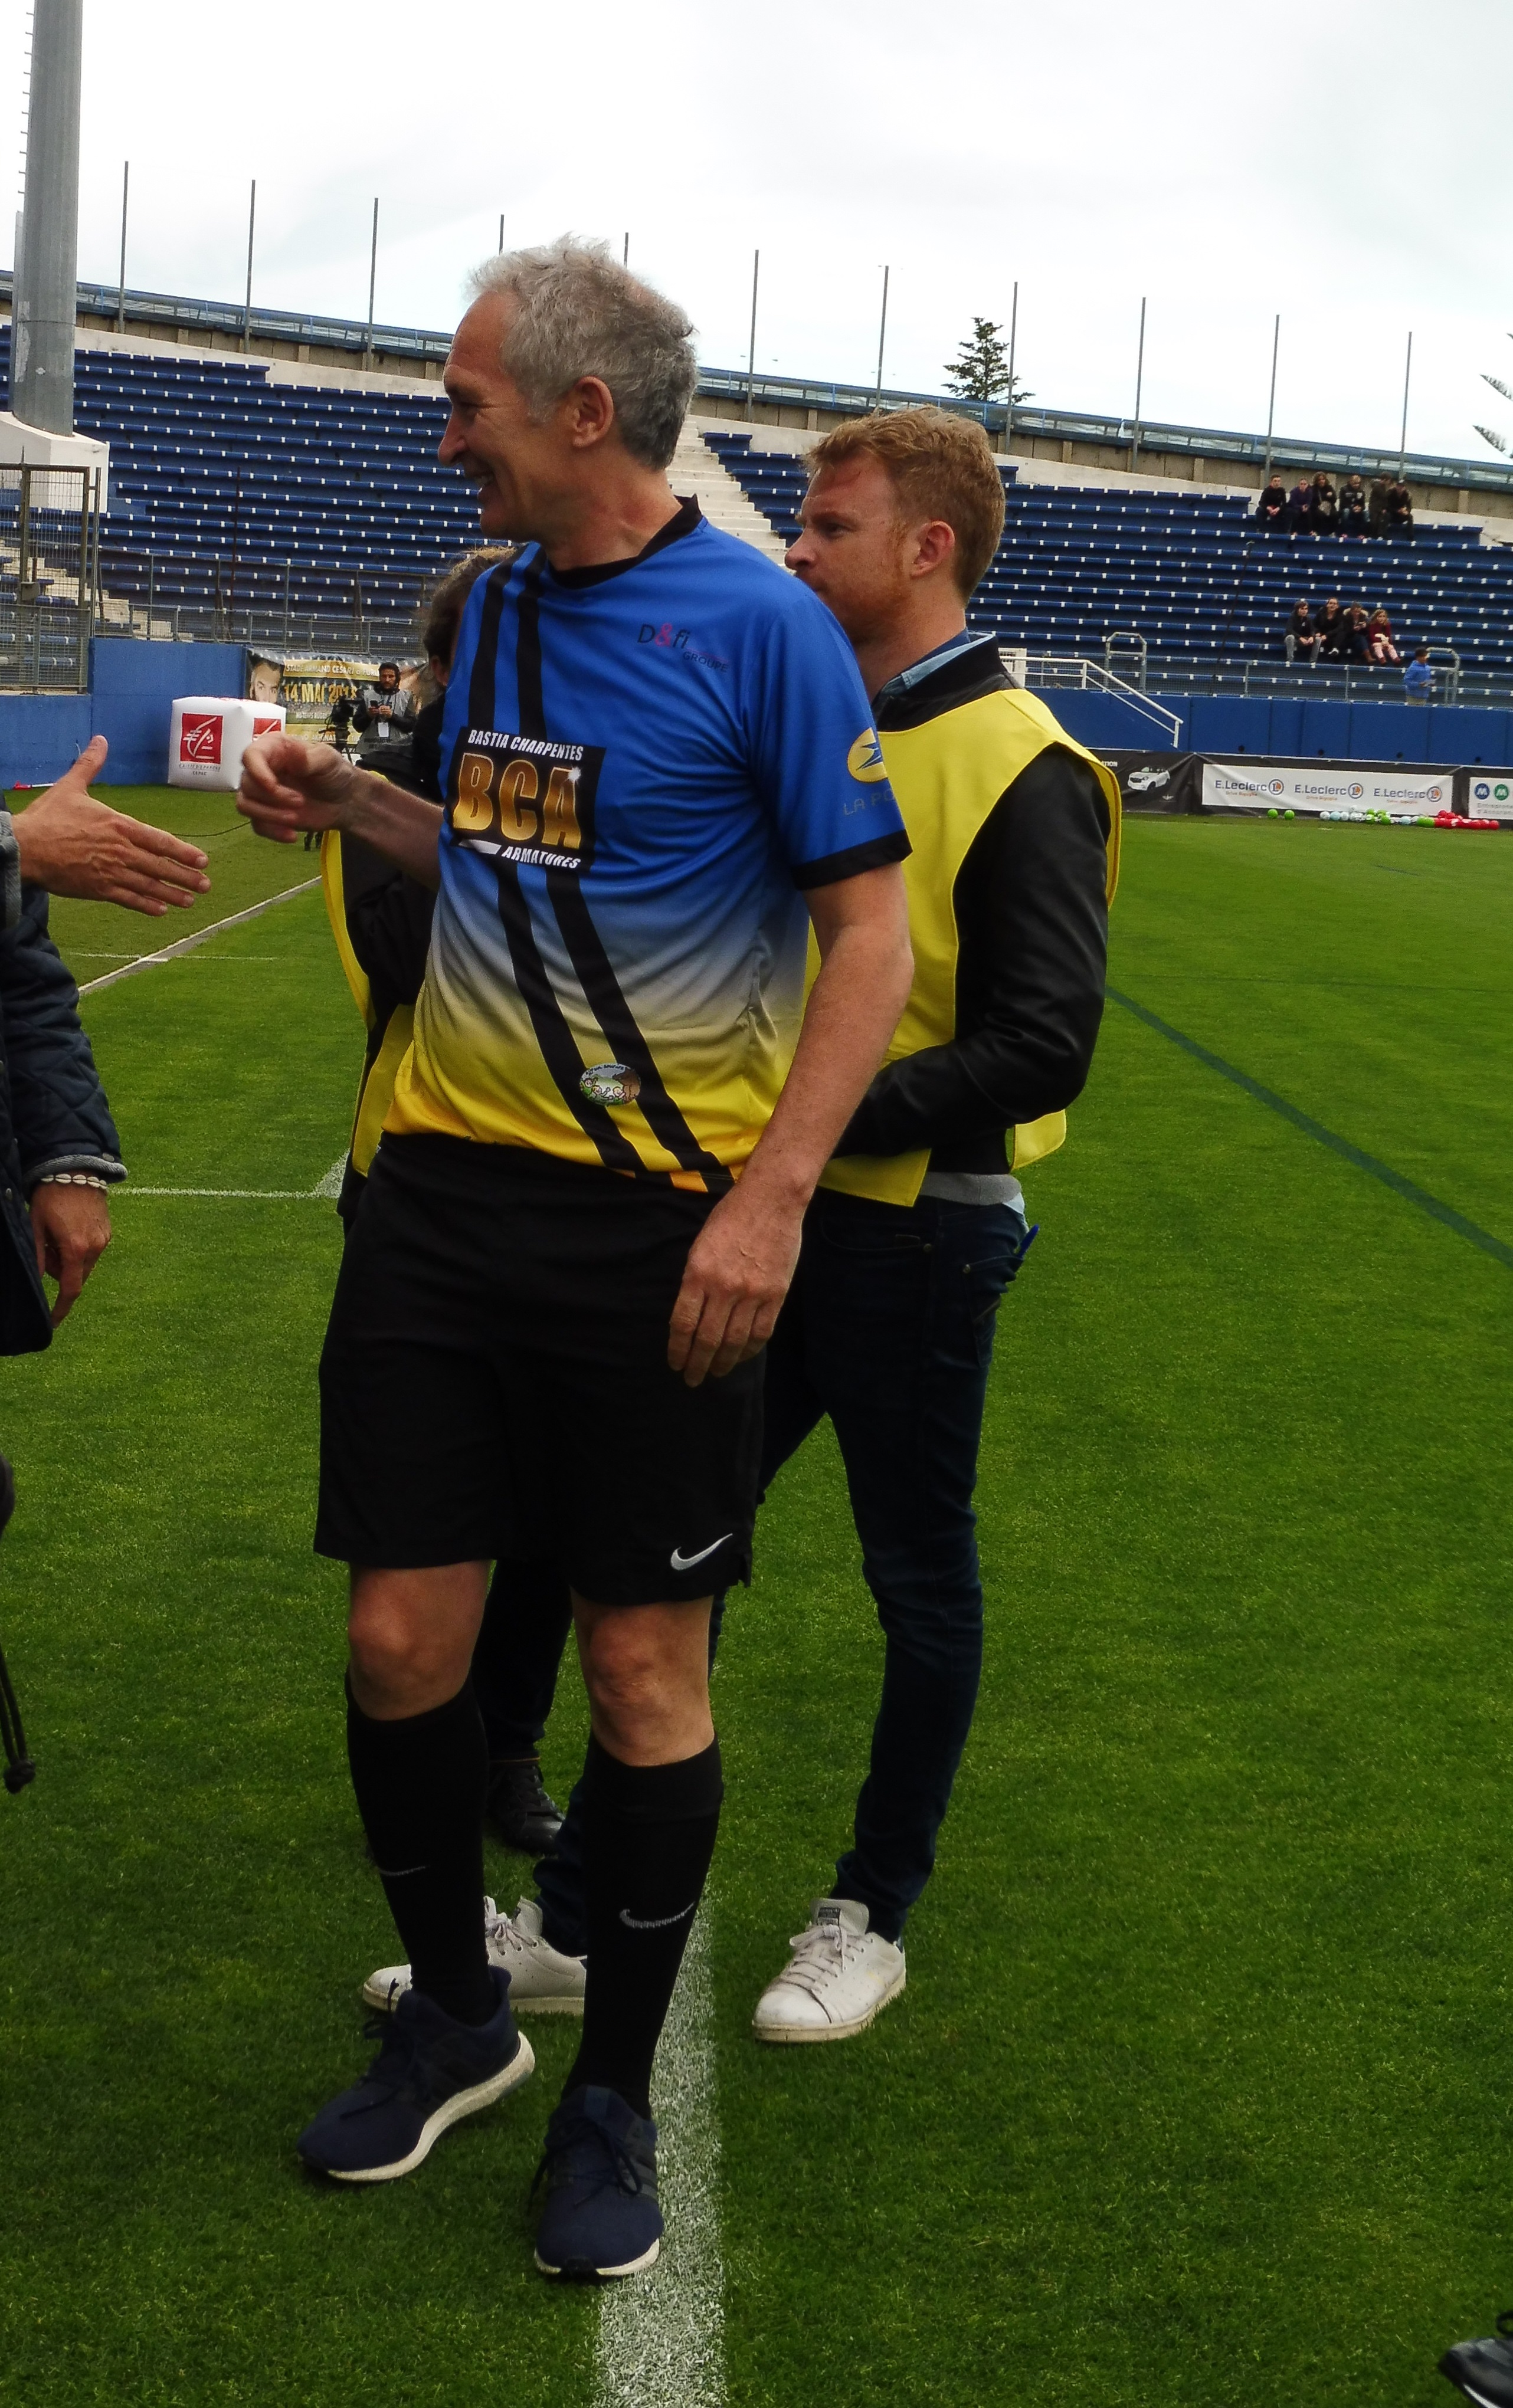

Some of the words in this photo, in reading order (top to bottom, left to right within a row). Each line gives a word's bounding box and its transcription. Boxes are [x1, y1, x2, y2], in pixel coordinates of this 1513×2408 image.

[637, 622, 691, 649] D&fi
[286, 664, 303, 672] STADE
[304, 665, 331, 673] ARMAND
[332, 665, 355, 675] CESARI
[682, 651, 729, 672] GROUPE
[284, 683, 299, 703] 14
[302, 683, 325, 703] MAI
[468, 729, 510, 749] BASTIA
[510, 736, 584, 762] CHARPENTES
[1215, 780, 1268, 792] E.Leclerc
[1295, 785, 1347, 796] E.Leclerc
[1374, 788, 1426, 799] E.Leclerc
[453, 752, 581, 850] BCA
[843, 798, 866, 815] LA
[502, 846, 581, 869] ARMATURES
